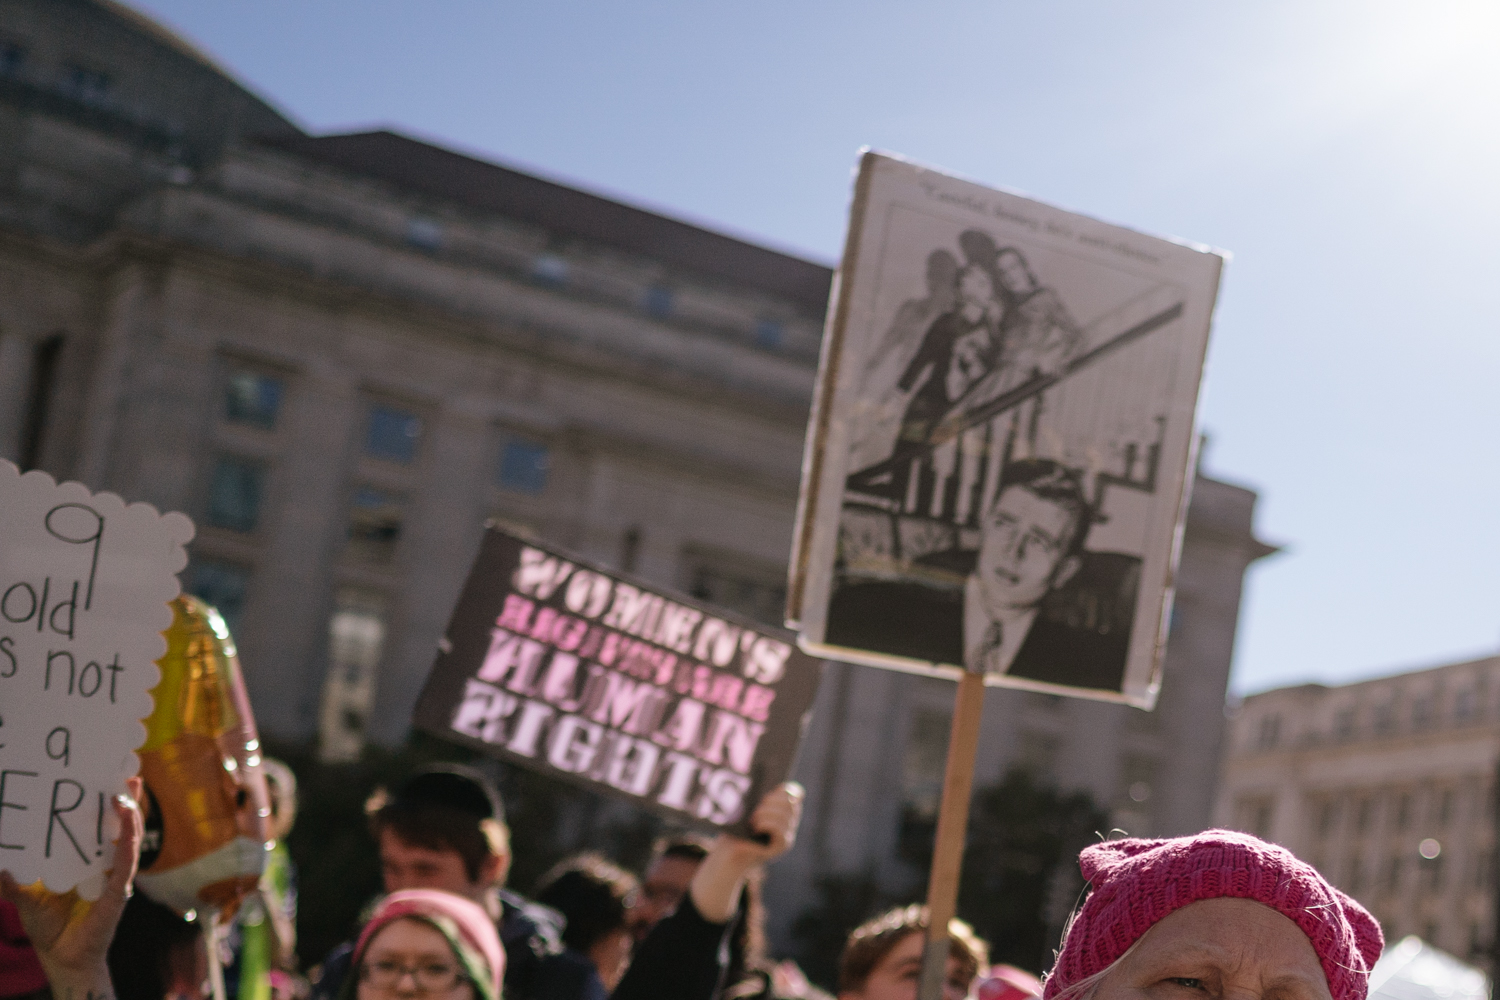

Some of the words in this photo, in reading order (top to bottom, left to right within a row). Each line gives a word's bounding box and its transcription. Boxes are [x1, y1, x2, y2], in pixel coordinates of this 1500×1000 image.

[1, 577, 79, 640] old
[511, 546, 792, 684] WOMEN'S
[45, 650, 125, 704] not
[477, 628, 767, 775] HUMAN
[46, 727, 71, 767] a
[451, 678, 751, 827] RIGHTS
